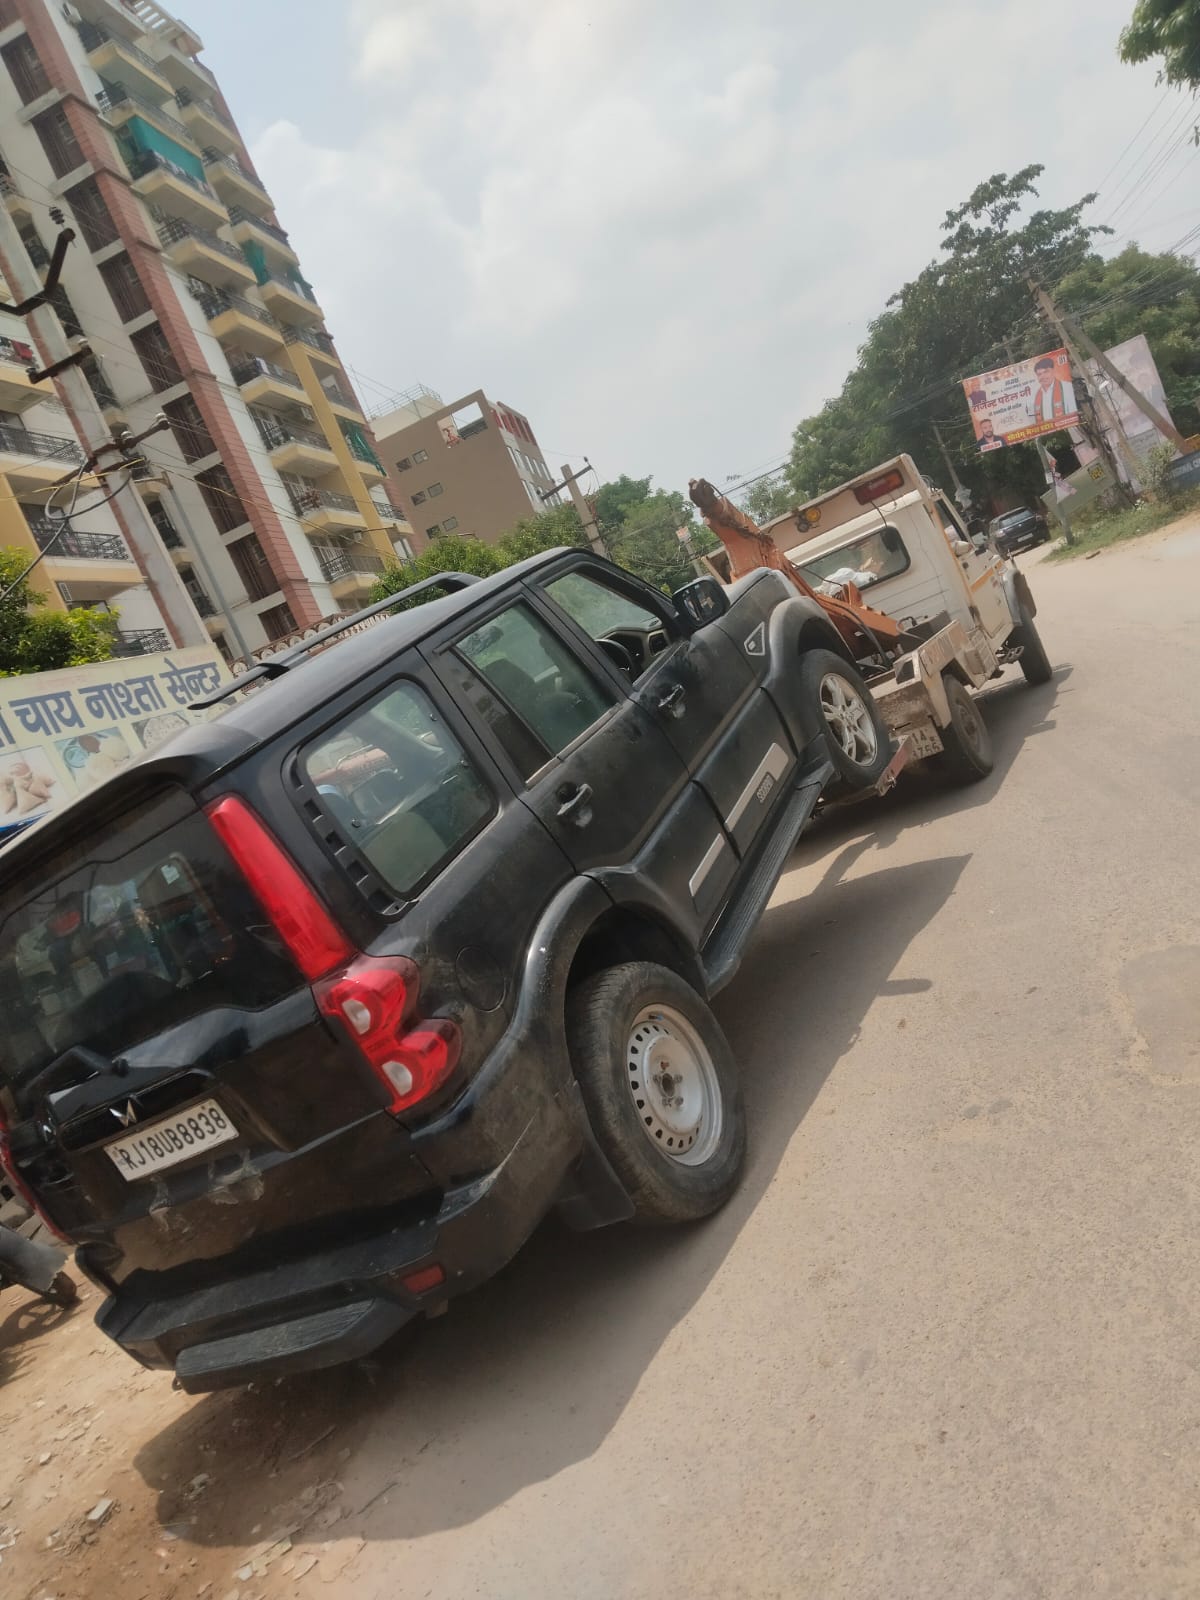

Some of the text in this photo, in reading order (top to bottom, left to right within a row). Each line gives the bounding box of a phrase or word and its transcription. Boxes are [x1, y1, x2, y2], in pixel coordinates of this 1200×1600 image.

[8, 690, 85, 737] चाय
[78, 674, 166, 721] नाश्ता
[159, 657, 221, 705] सेन्टर
[119, 1107, 227, 1170] RJ18UB8838
